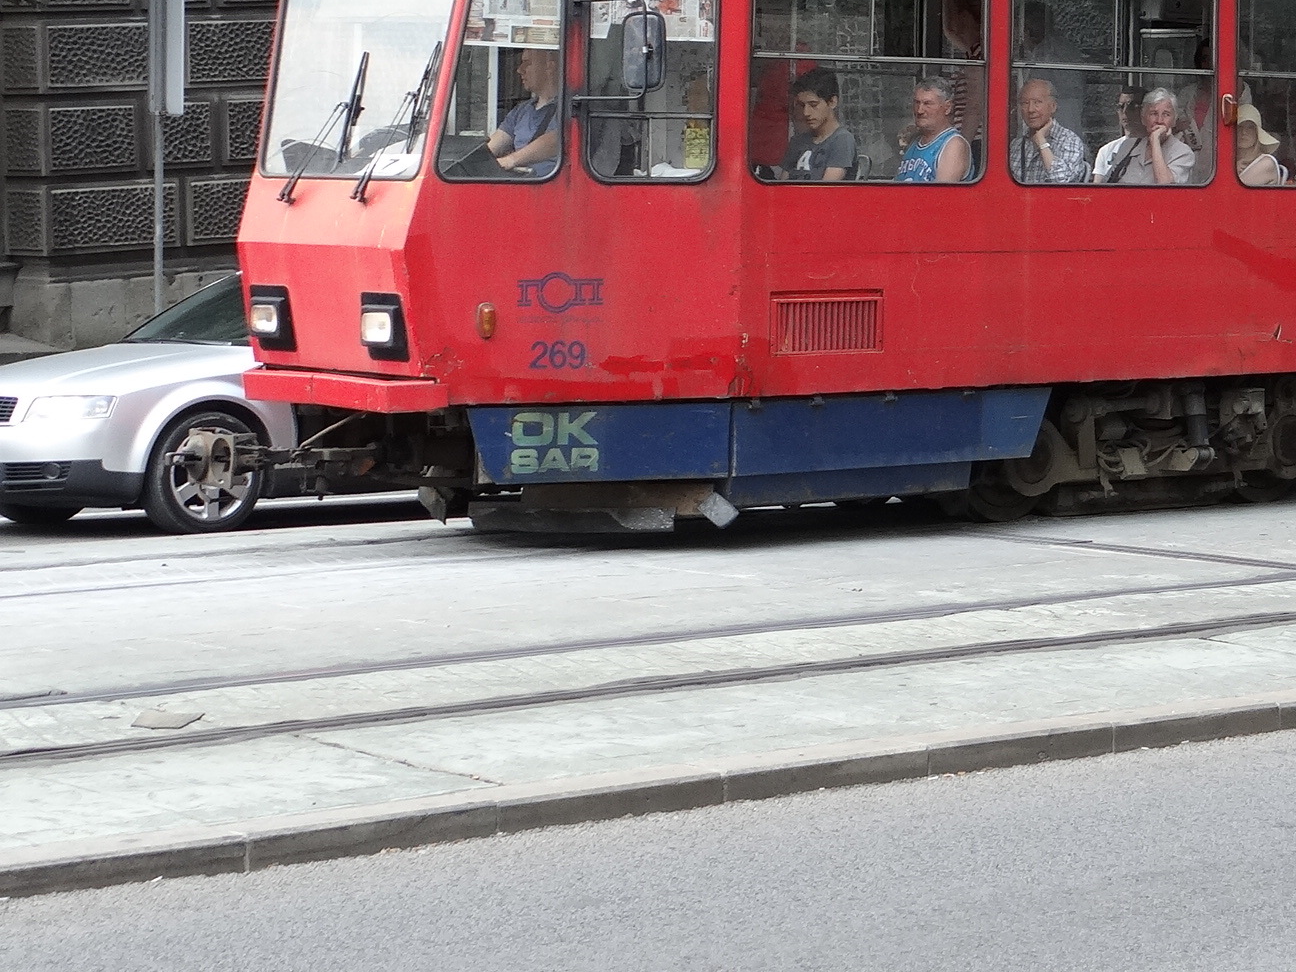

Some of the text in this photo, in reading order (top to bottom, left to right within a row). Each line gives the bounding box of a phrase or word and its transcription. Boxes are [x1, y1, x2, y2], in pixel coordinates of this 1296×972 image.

[382, 158, 400, 170] 7
[529, 340, 586, 369] 269
[512, 411, 599, 446] OK
[511, 447, 600, 474] SAR
